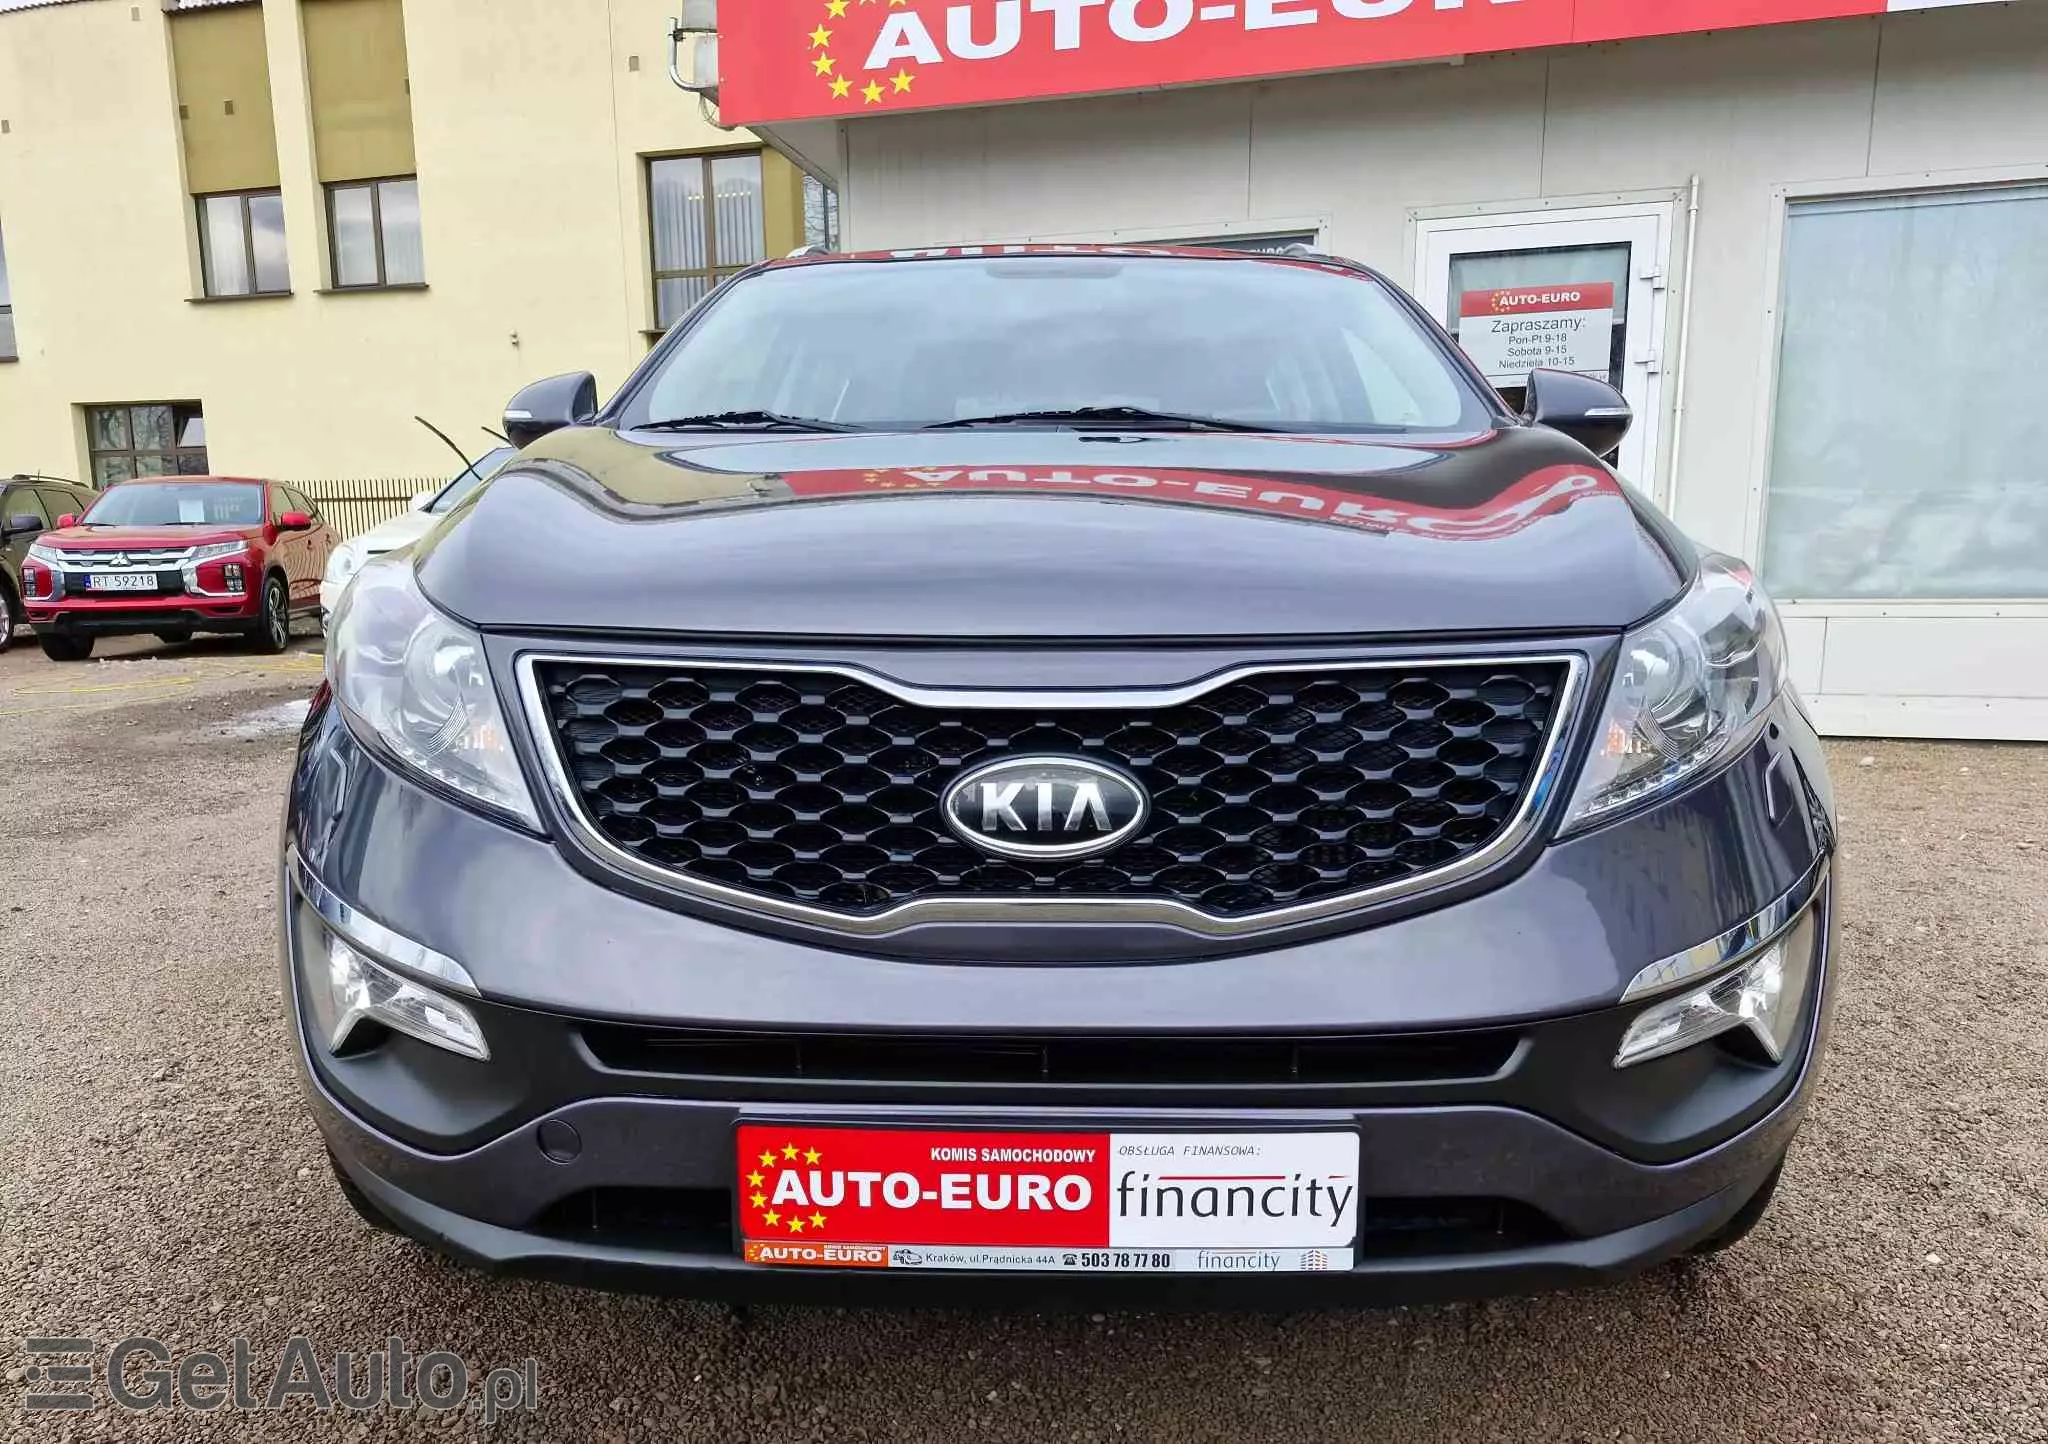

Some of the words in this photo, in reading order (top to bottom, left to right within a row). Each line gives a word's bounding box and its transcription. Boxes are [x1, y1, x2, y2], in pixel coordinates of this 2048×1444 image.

[863, 0, 1519, 70] AUTO-E
[1499, 291, 1581, 306] AUTO-EURO
[1491, 316, 1586, 334] Zapraszamy:
[1508, 333, 1543, 345] Pon-Pt
[1544, 332, 1568, 343] 9-18
[1506, 346, 1543, 357] Sobota
[1544, 344, 1568, 354] 9-15
[1498, 359, 1543, 369] Niedziela
[1548, 357, 1575, 366] 10-15
[92, 575, 109, 588] RT
[114, 575, 154, 587] 59218
[980, 782, 1113, 831] KIA
[930, 1147, 977, 1161] KOMIS
[981, 1148, 1096, 1163] SAMOCHODOWY
[1119, 1145, 1175, 1156] OBSŁUGA
[1183, 1145, 1263, 1156] FINANSOWA:
[771, 1169, 1093, 1212] AUTO-EURO
[1116, 1170, 1353, 1227] financity
[760, 1247, 882, 1262] AUTO-EURO
[926, 1253, 967, 1265] Kraków,
[1036, 1255, 1056, 1264] 44A
[1081, 1252, 1110, 1268] 503
[1197, 1251, 1280, 1272] financity
